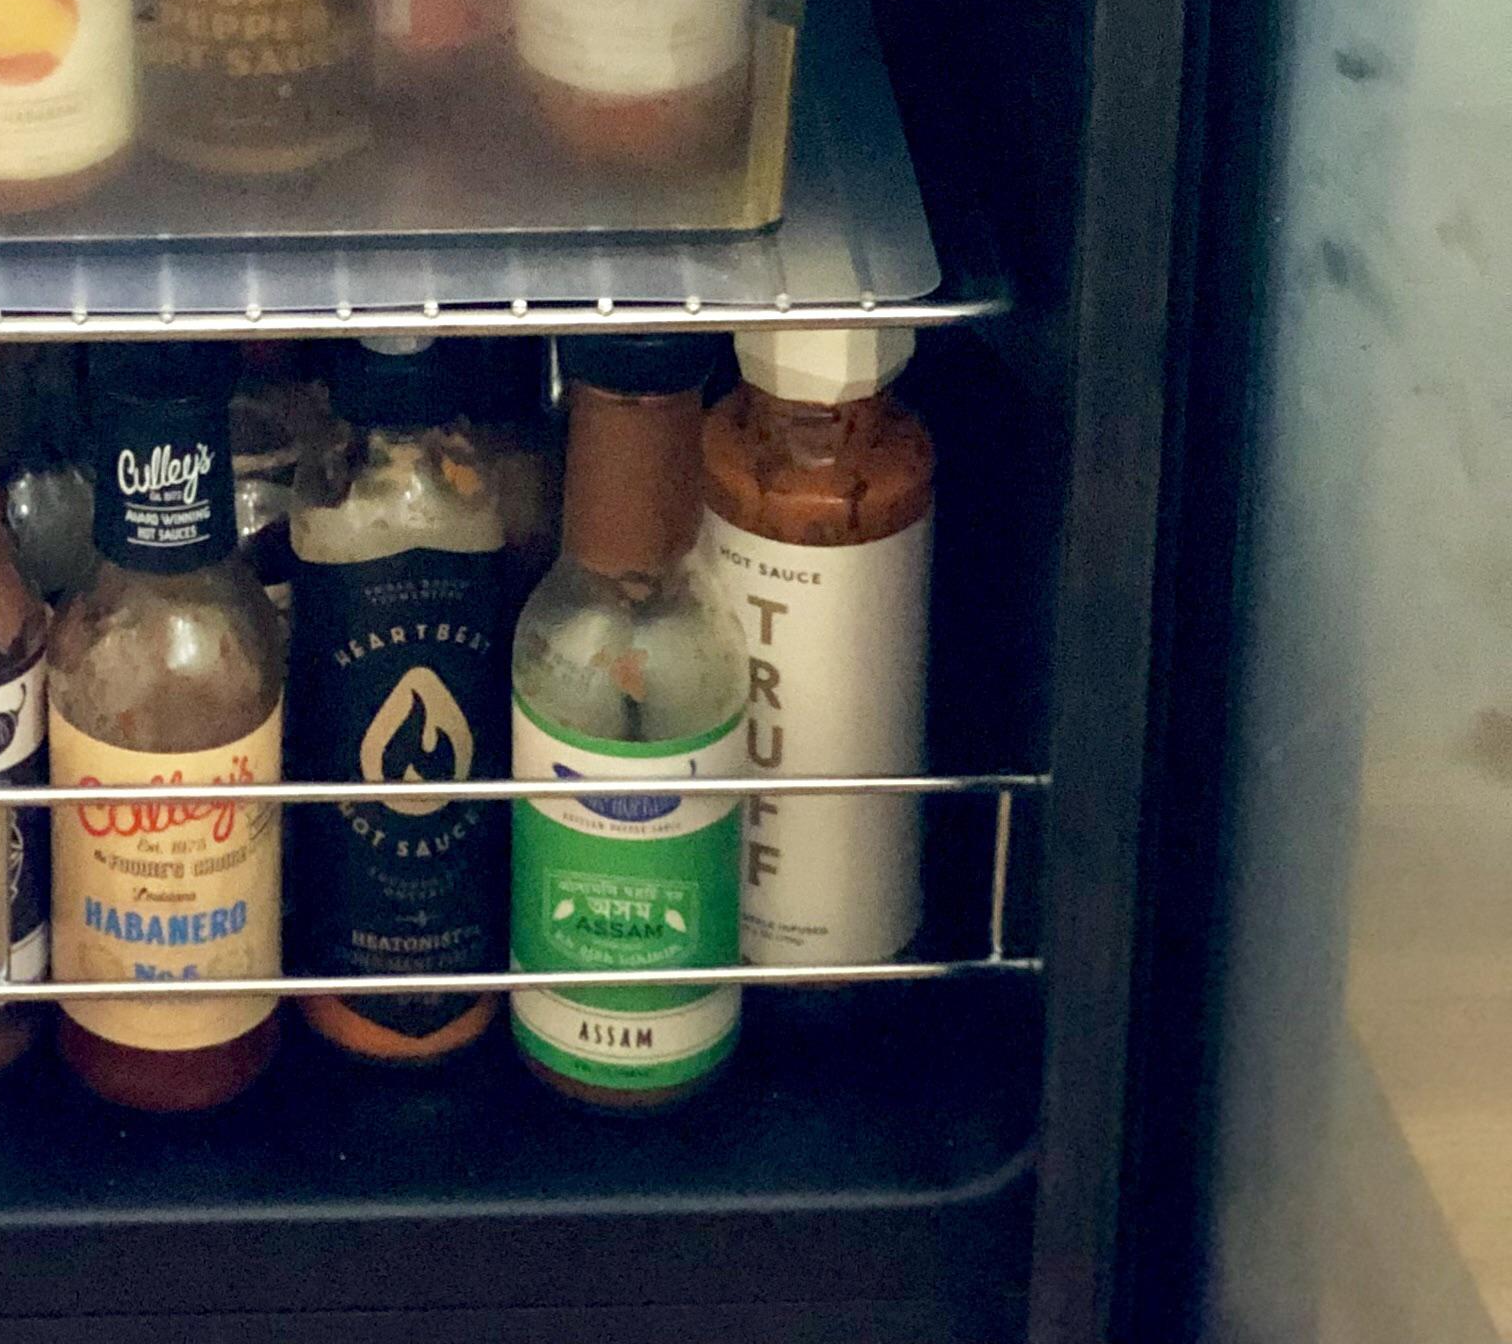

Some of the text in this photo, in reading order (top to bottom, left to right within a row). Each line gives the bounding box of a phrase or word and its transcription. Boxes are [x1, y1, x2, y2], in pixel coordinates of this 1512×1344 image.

[118, 443, 216, 505] Culley's
[161, 506, 212, 525] WINNING
[158, 525, 197, 542] SAUCES
[719, 546, 823, 586] HOT SAUCE
[84, 896, 248, 947] HABANERO
[575, 915, 665, 940] ASSAM
[578, 1019, 654, 1049] ASSAM
